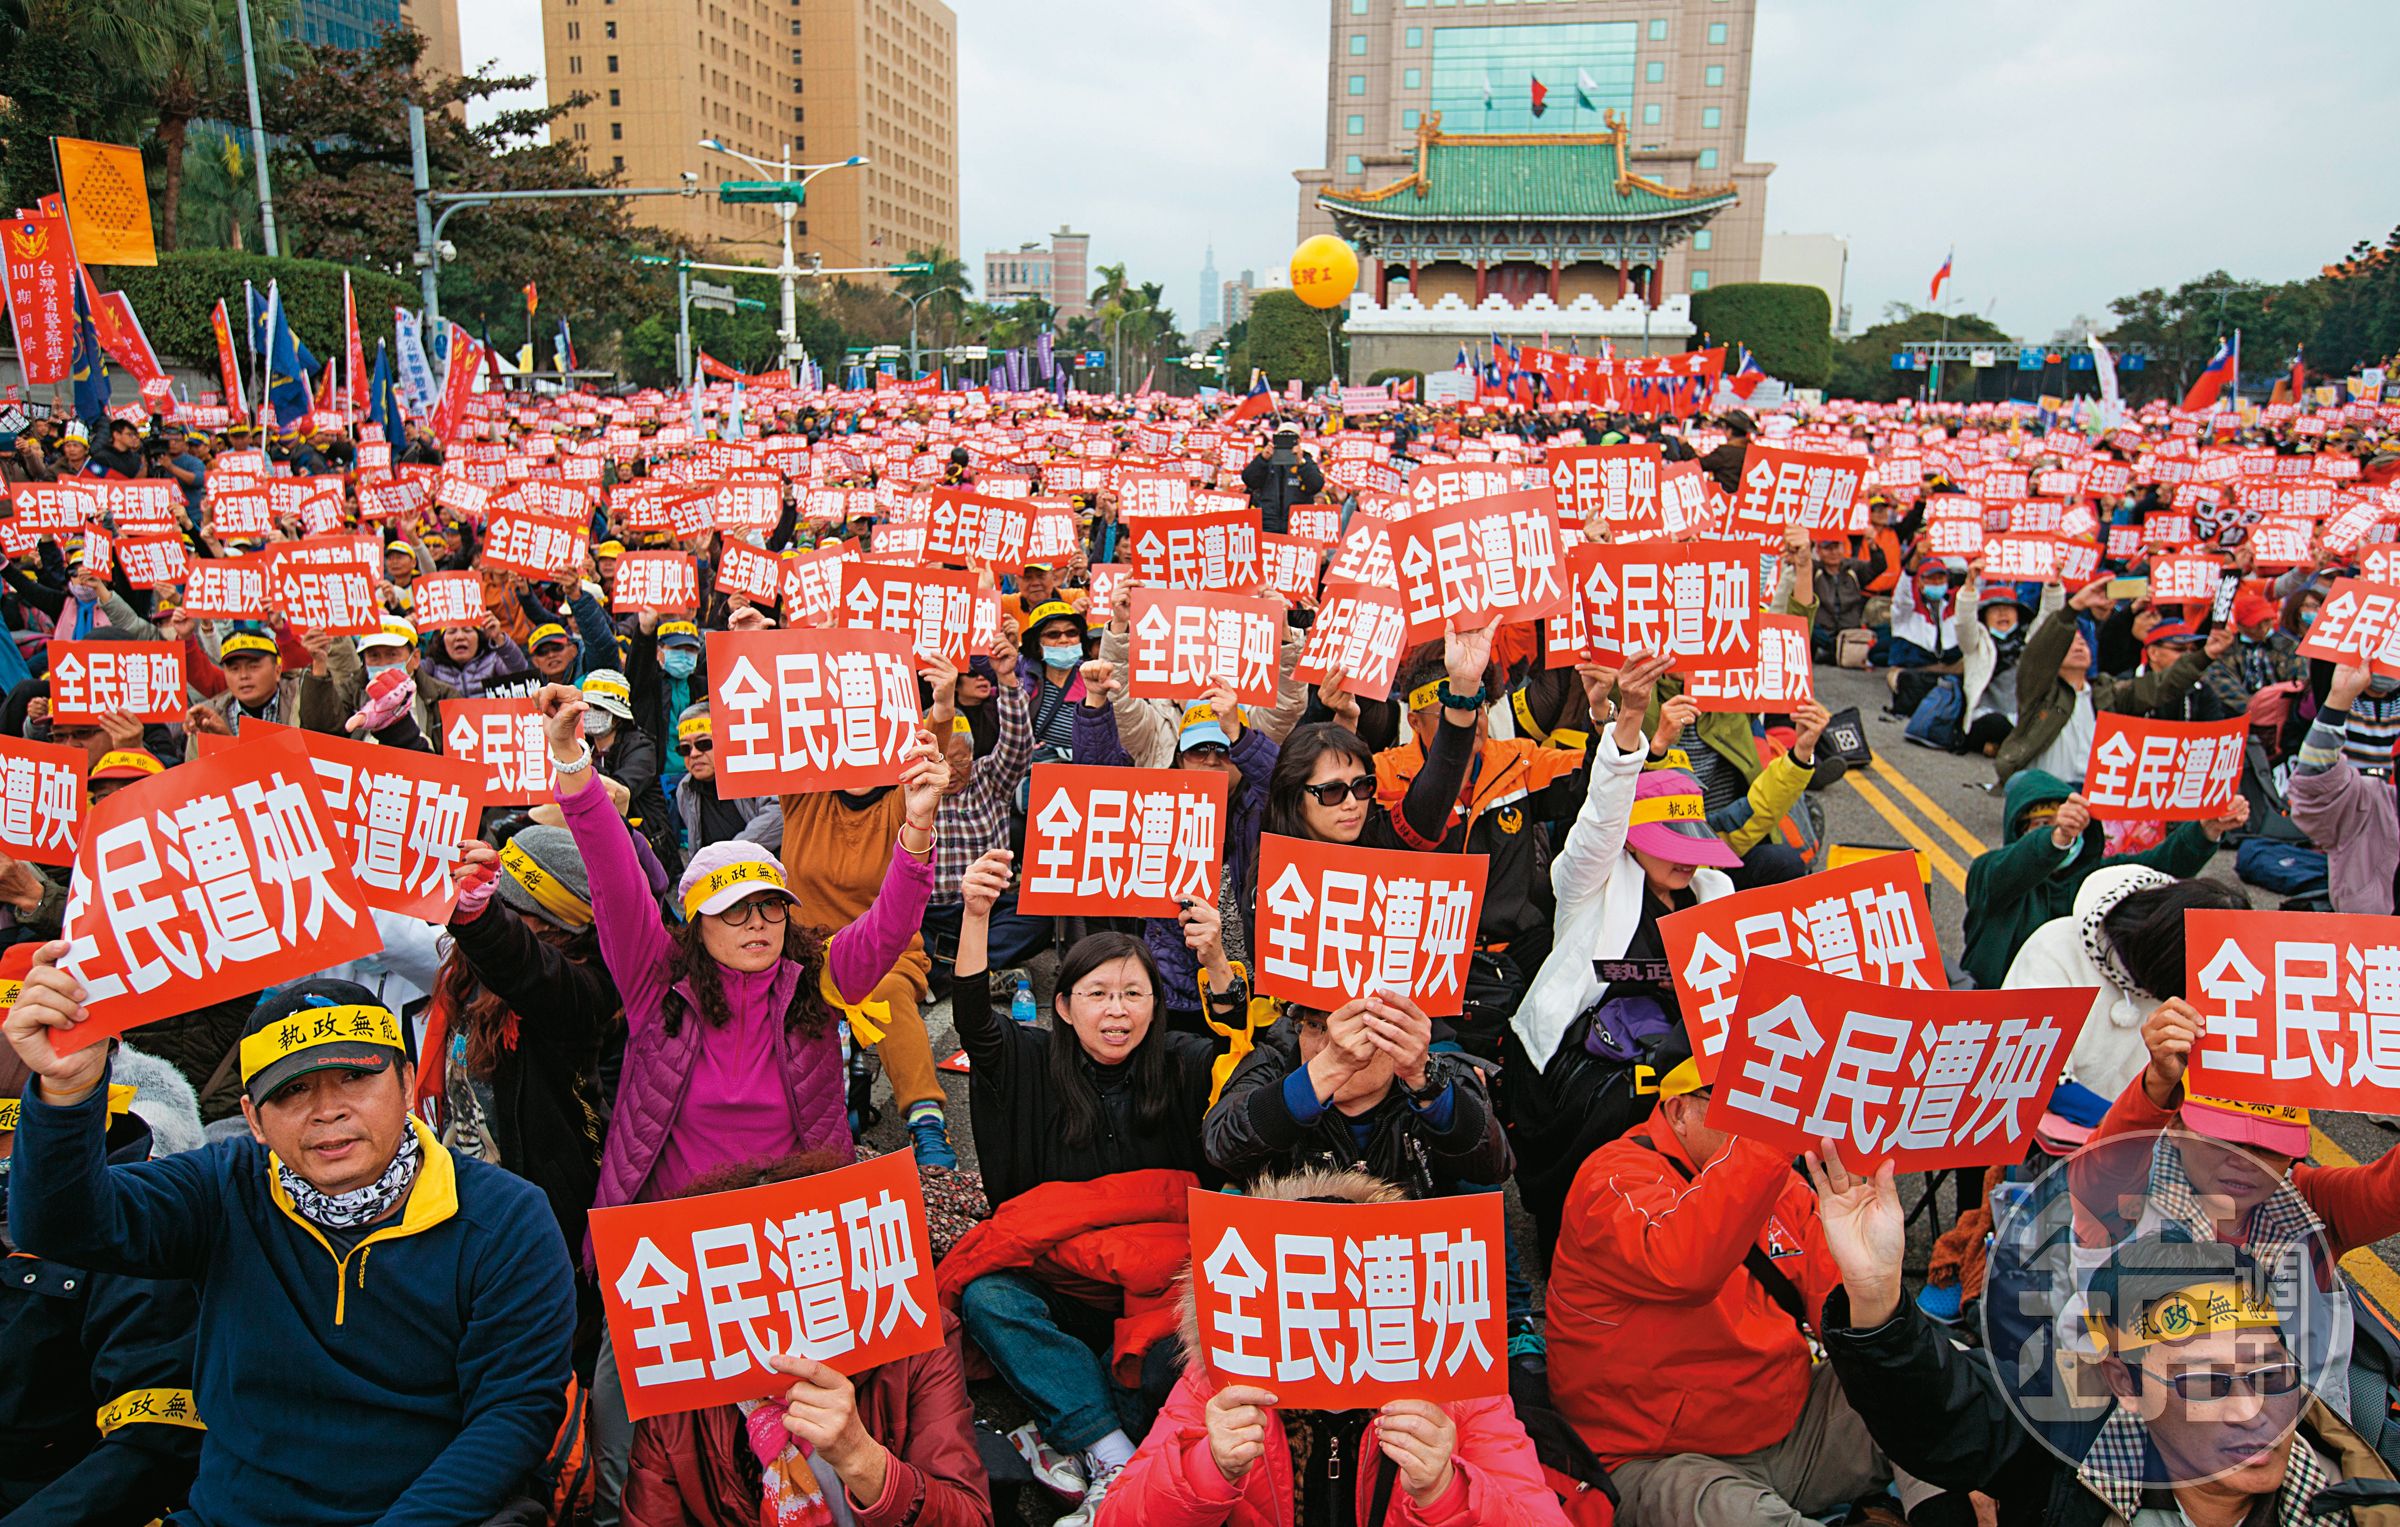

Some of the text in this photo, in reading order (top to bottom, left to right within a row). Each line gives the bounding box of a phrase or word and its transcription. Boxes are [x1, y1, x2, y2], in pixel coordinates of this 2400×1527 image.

[39, 260, 63, 377] 台灣省警察學校
[358, 447, 390, 468] 全民遭殃
[467, 464, 507, 487] 全民遭殃
[563, 459, 599, 479] 全民遭殃
[710, 445, 753, 471] 全民遭殃
[767, 452, 810, 477] 全民遭殃
[1047, 466, 1082, 489] 全民遭殃
[1879, 460, 1921, 486] 全民遭殃
[2152, 461, 2192, 483] 全民遭殃
[378, 480, 428, 512] 全民遭殃
[438, 478, 488, 512] 全民遭殃
[1121, 479, 1188, 517] 全民遭殃
[1368, 465, 1401, 493] 全民遭殃
[1413, 471, 1507, 512] 全民遭殃
[1552, 457, 1656, 521] 全民遭殃
[1739, 459, 1858, 530] 全民遭殃
[1985, 473, 2027, 498] 全民遭殃
[2039, 473, 2077, 493] 全民遭殃
[17, 489, 98, 528] 全民遭殃
[110, 486, 172, 520] 全民遭殃
[215, 495, 273, 533] 全民遭殃
[542, 484, 584, 517] 全民遭殃
[718, 487, 778, 524] 全民遭殃
[804, 490, 845, 517] 全民遭殃
[1936, 498, 1982, 518] 全民遭殃
[2011, 503, 2062, 532] 全民遭殃
[2280, 489, 2331, 515] 全民遭殃
[486, 517, 571, 571] 全民遭殃
[929, 500, 1034, 566] 全民遭殃
[1290, 511, 1339, 543] 全民遭殃
[1929, 521, 1983, 552] 全民遭殃
[2143, 516, 2190, 542] 全民遭殃
[2252, 528, 2312, 561] 全民遭殃
[120, 538, 188, 583] 全民遭殃
[719, 547, 779, 600] 全民遭殃
[1137, 523, 1258, 590] 全民遭殃
[1332, 526, 1399, 590] 全民
[1400, 508, 1561, 625] 全民遭殃
[1984, 539, 2054, 575] 全民遭殃
[185, 567, 263, 613] 全民遭殃
[283, 572, 376, 628] 全民遭殃
[614, 560, 683, 605] 全民遭殃
[784, 550, 861, 622] 全民遭
[2155, 561, 2222, 598] 全民遭殃
[416, 579, 483, 623] 全民遭殃
[846, 577, 971, 661] 全民遭殃
[1585, 560, 1750, 657] 全民遭殃
[1136, 603, 1275, 692] 全民遭殃
[1300, 597, 1404, 685] 全民遭殃
[55, 652, 182, 714] 全民遭殃
[720, 651, 919, 773] 全民遭殃
[449, 712, 557, 792] 全民遭
[2090, 730, 2243, 810] 全民遭殃
[1030, 787, 1215, 901] 全民遭殃
[1264, 863, 1473, 998] 全民遭殃
[278, 1009, 398, 1051] 執政無能
[1728, 994, 2062, 1154] 全民遭殃
[616, 1189, 926, 1388] 全民遭殃
[1203, 1227, 1495, 1385] 全民遭殃
